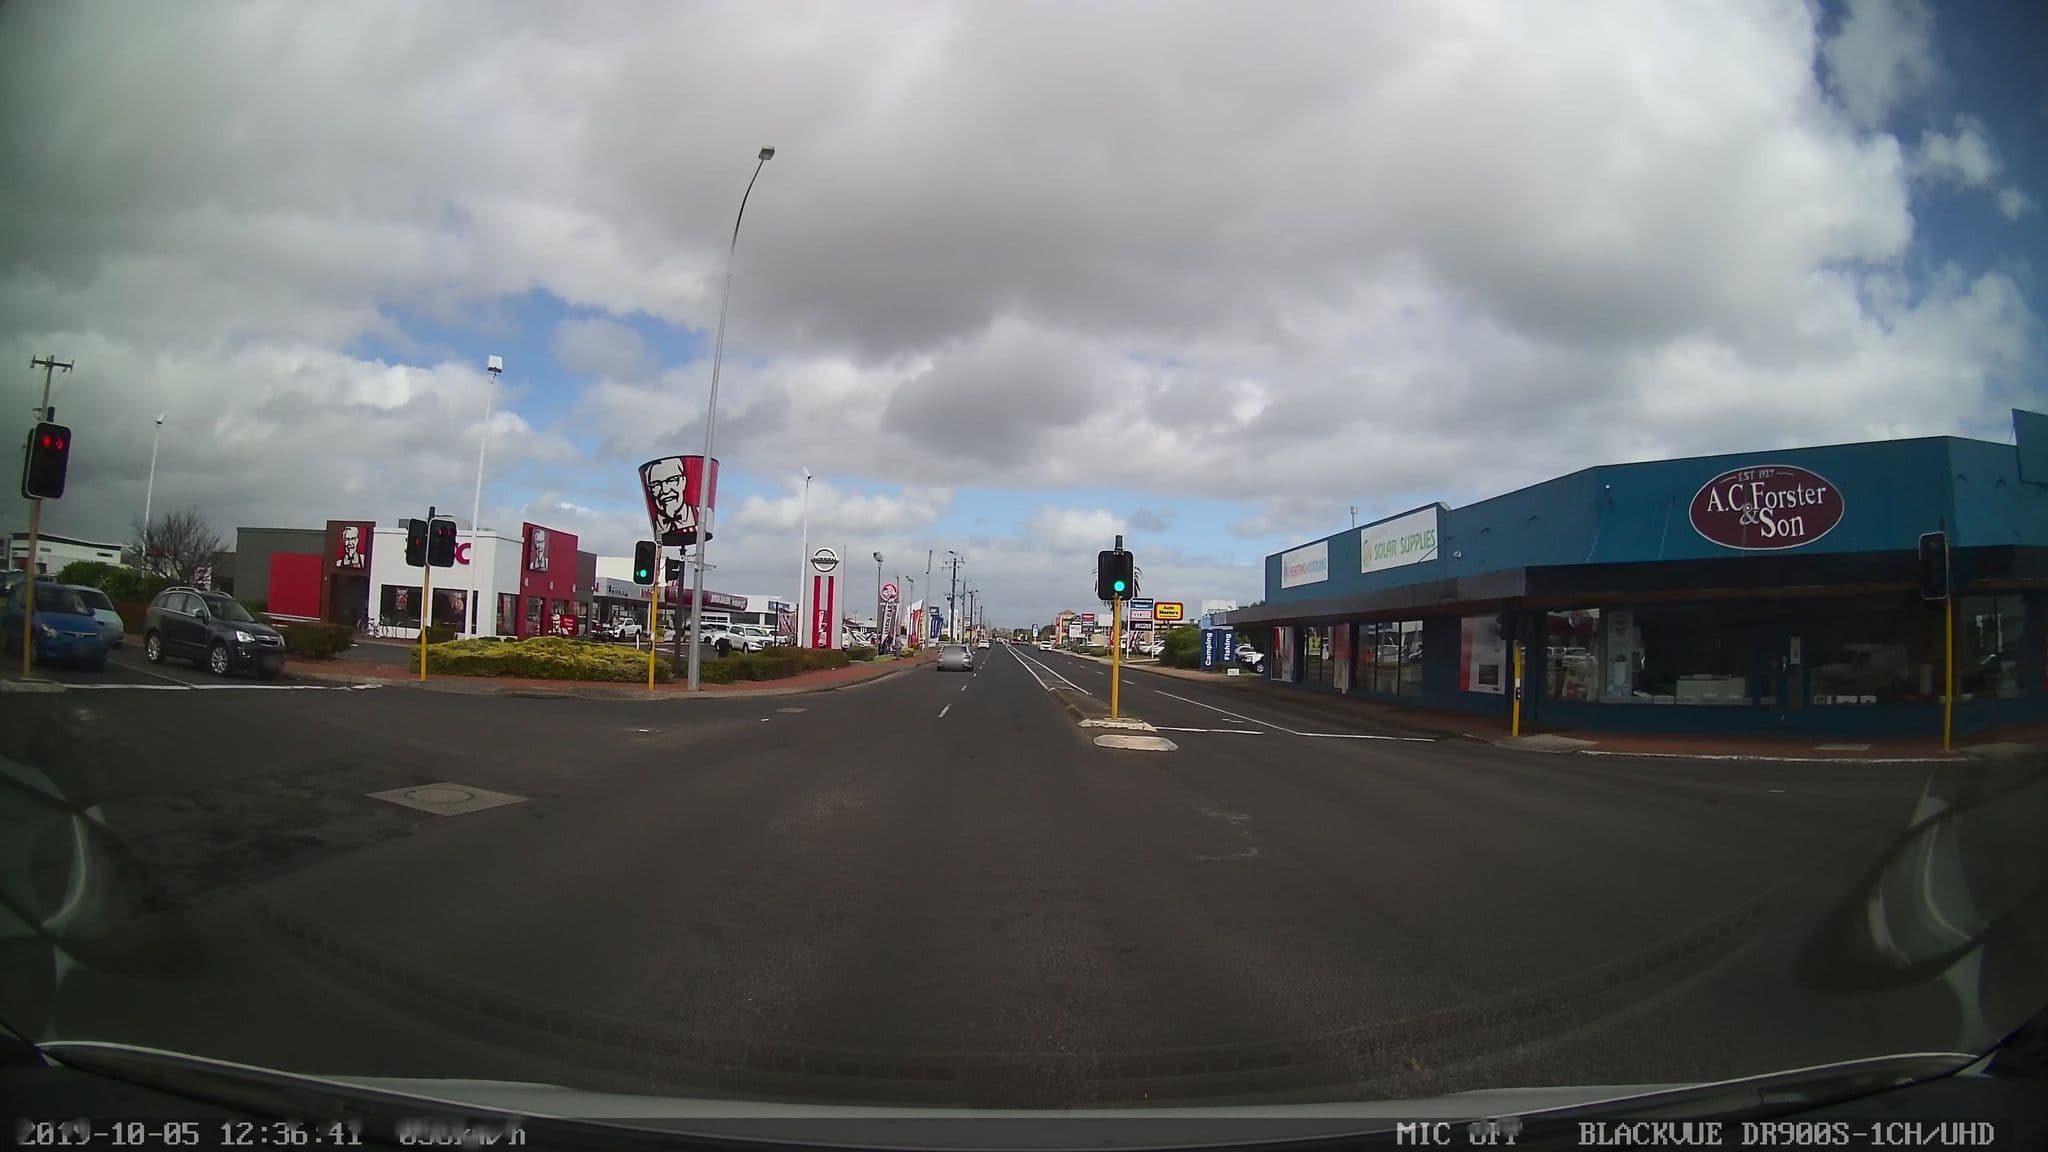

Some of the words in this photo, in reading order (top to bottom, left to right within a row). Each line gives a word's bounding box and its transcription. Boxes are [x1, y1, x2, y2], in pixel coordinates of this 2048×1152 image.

[1750, 482, 1827, 509] Forster
[1759, 507, 1805, 538] Son
[1400, 529, 1436, 554] SUPPLIES
[1205, 632, 1213, 666] Camping
[1223, 633, 1232, 661] Fishing
